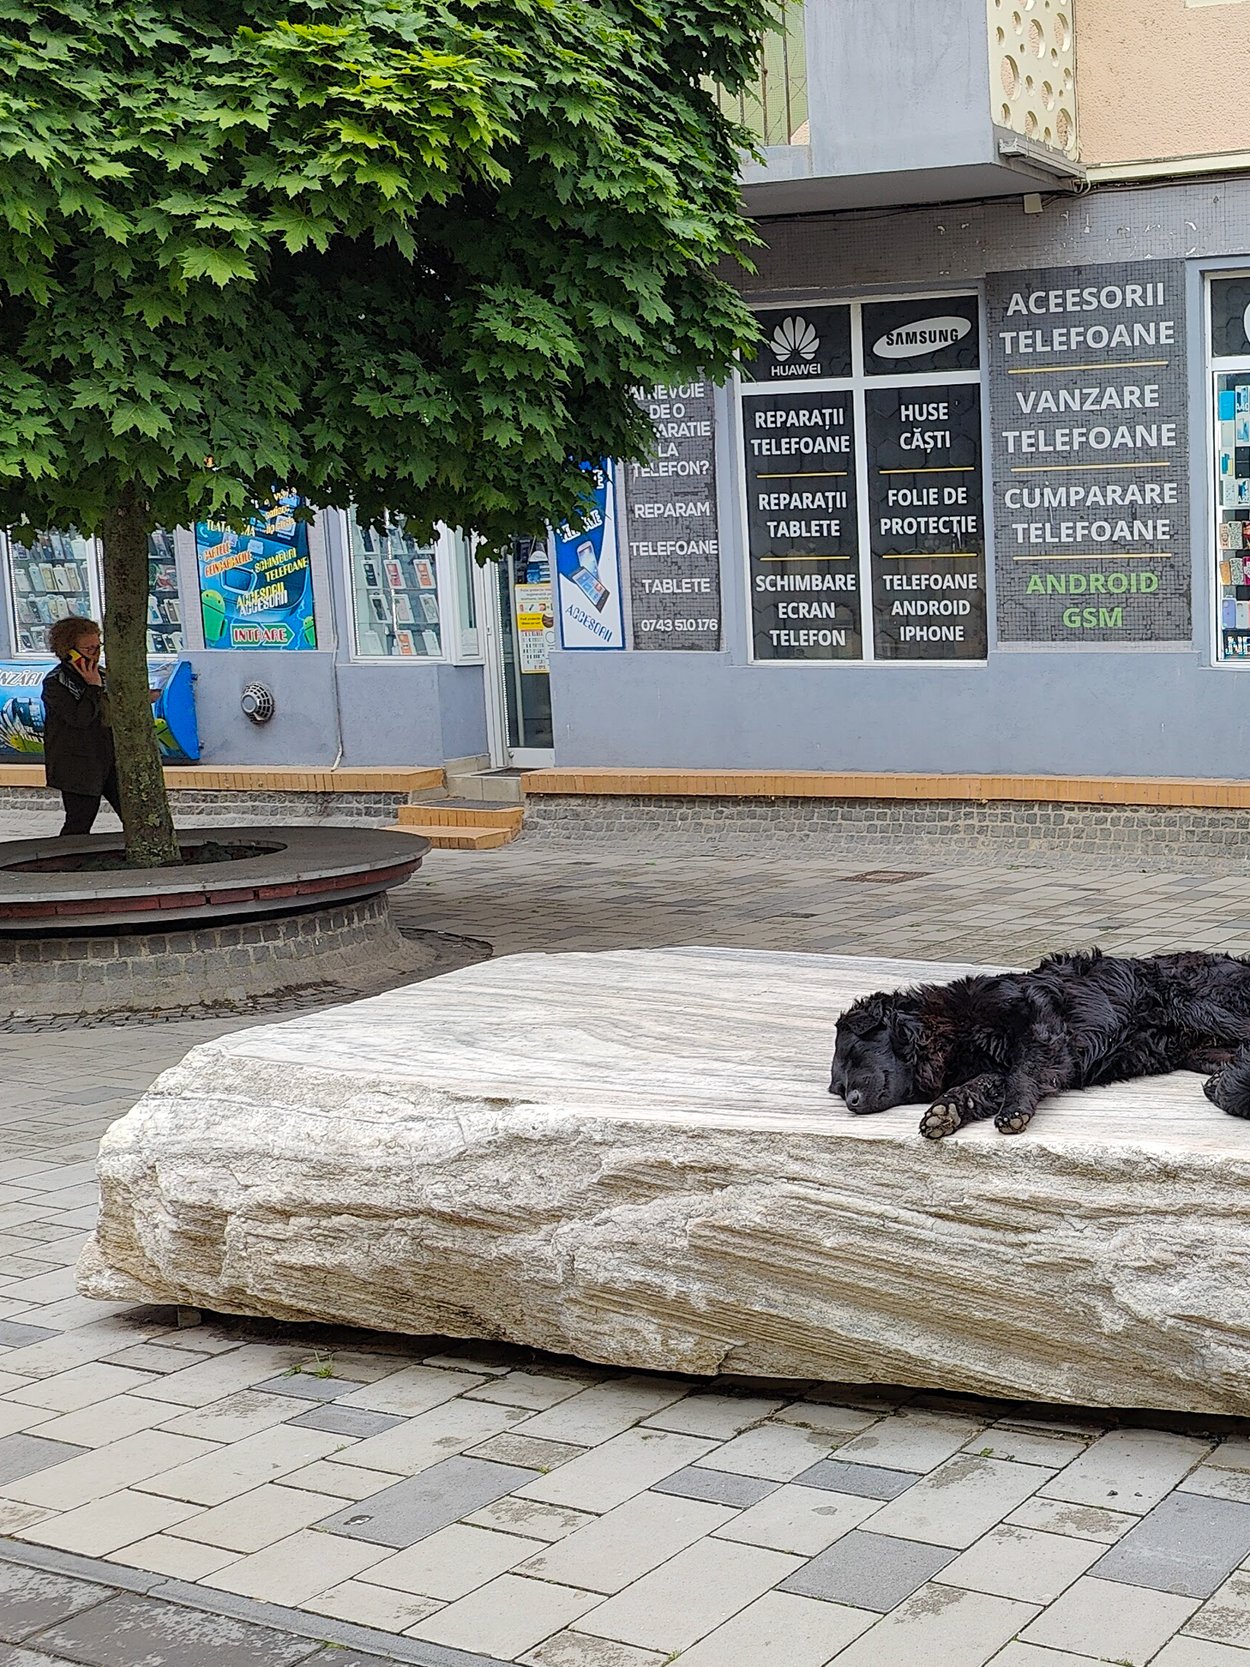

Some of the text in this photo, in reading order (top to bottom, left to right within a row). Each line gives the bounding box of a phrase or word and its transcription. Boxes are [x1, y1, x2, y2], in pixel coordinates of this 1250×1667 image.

[1007, 283, 1164, 316] ACEESORII
[886, 328, 959, 347] SAMSUNG
[1000, 321, 1175, 354] TELEFOANE
[771, 364, 821, 377] HUAWEI
[1016, 384, 1160, 414] VANZARE
[649, 403, 685, 419] DE O
[755, 408, 844, 430] REPARAȚII
[901, 402, 948, 421] HUSE
[651, 421, 711, 438] ARATIE
[1002, 423, 1176, 453] TELEFOANE
[657, 443, 679, 457] LA
[751, 435, 850, 457] TELEFOANE
[900, 427, 951, 454] CĂȘTI
[632, 460, 709, 478] TELEFON?
[758, 491, 847, 513] REPARAȚII
[888, 487, 967, 507] FOLIE DE
[1004, 483, 1178, 509] CUMPARARE
[634, 502, 710, 518] REPARAM
[767, 519, 840, 538] TABLETE
[880, 515, 977, 536] PROTECȚIE
[1012, 519, 1170, 543] TELEFOANE
[630, 540, 718, 556] TELEFOANE
[642, 578, 710, 594] TABLETE
[756, 573, 856, 592] SCHIMBARE
[883, 574, 977, 591] TELEFOANE
[1026, 572, 1159, 594] ANDROID
[778, 602, 836, 619] ECRAN
[892, 600, 971, 616] ANDROID
[1062, 607, 1124, 628] GSM
[565, 603, 613, 643] ACCESORII
[641, 619, 718, 632] 0743 510 176
[233, 628, 288, 642] INTRARE
[770, 630, 846, 647] TELEFON
[900, 626, 965, 642] IPHONE
[0, 668, 43, 687] NZĂRI
